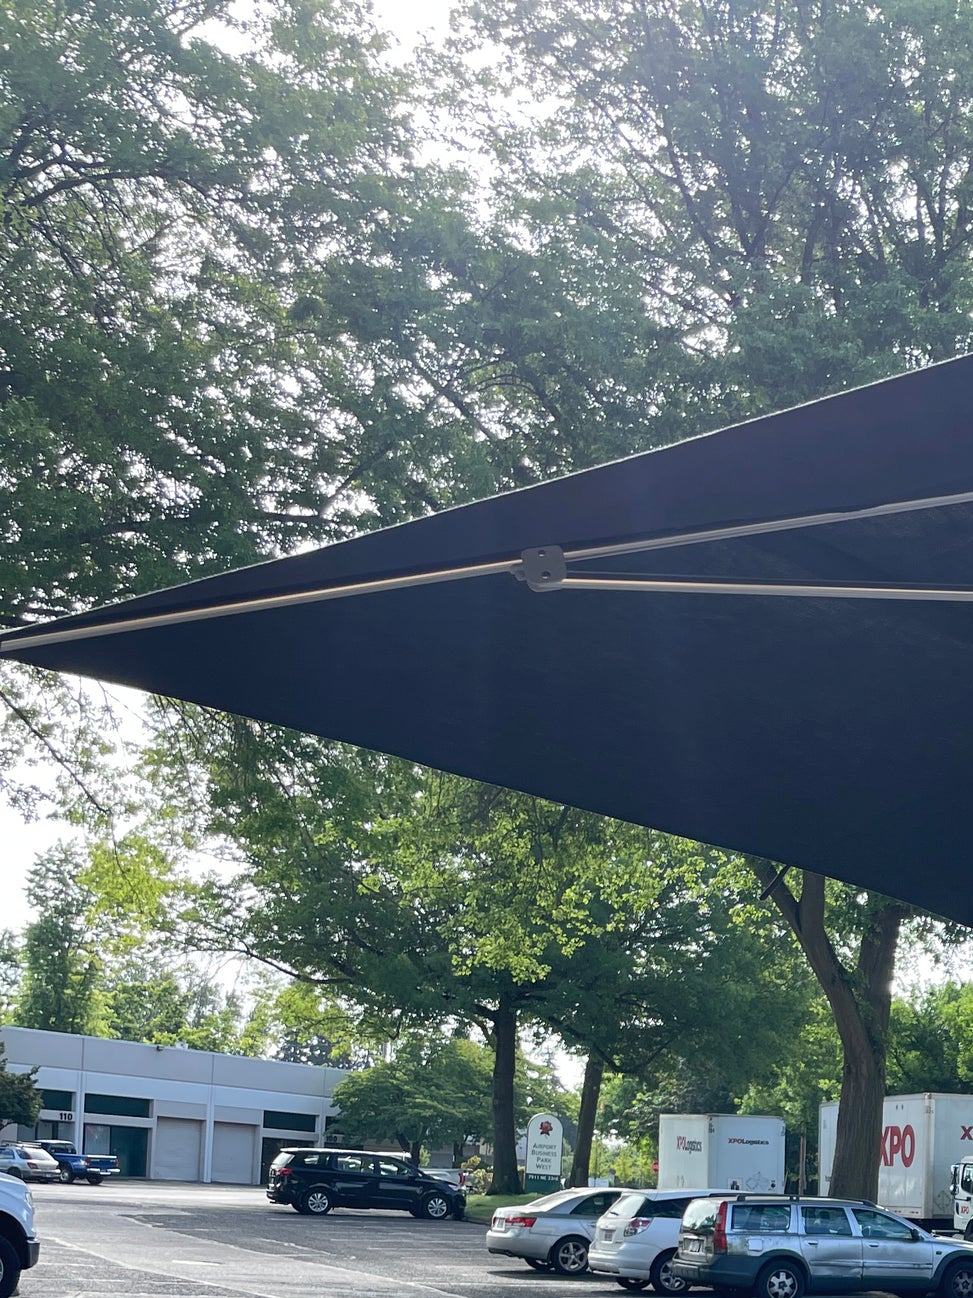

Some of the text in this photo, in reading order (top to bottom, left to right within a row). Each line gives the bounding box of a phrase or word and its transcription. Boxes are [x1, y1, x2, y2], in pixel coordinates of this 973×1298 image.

[60, 1113, 73, 1121] 110
[880, 1124, 916, 1168] XPO
[961, 1206, 970, 1214] XPO
